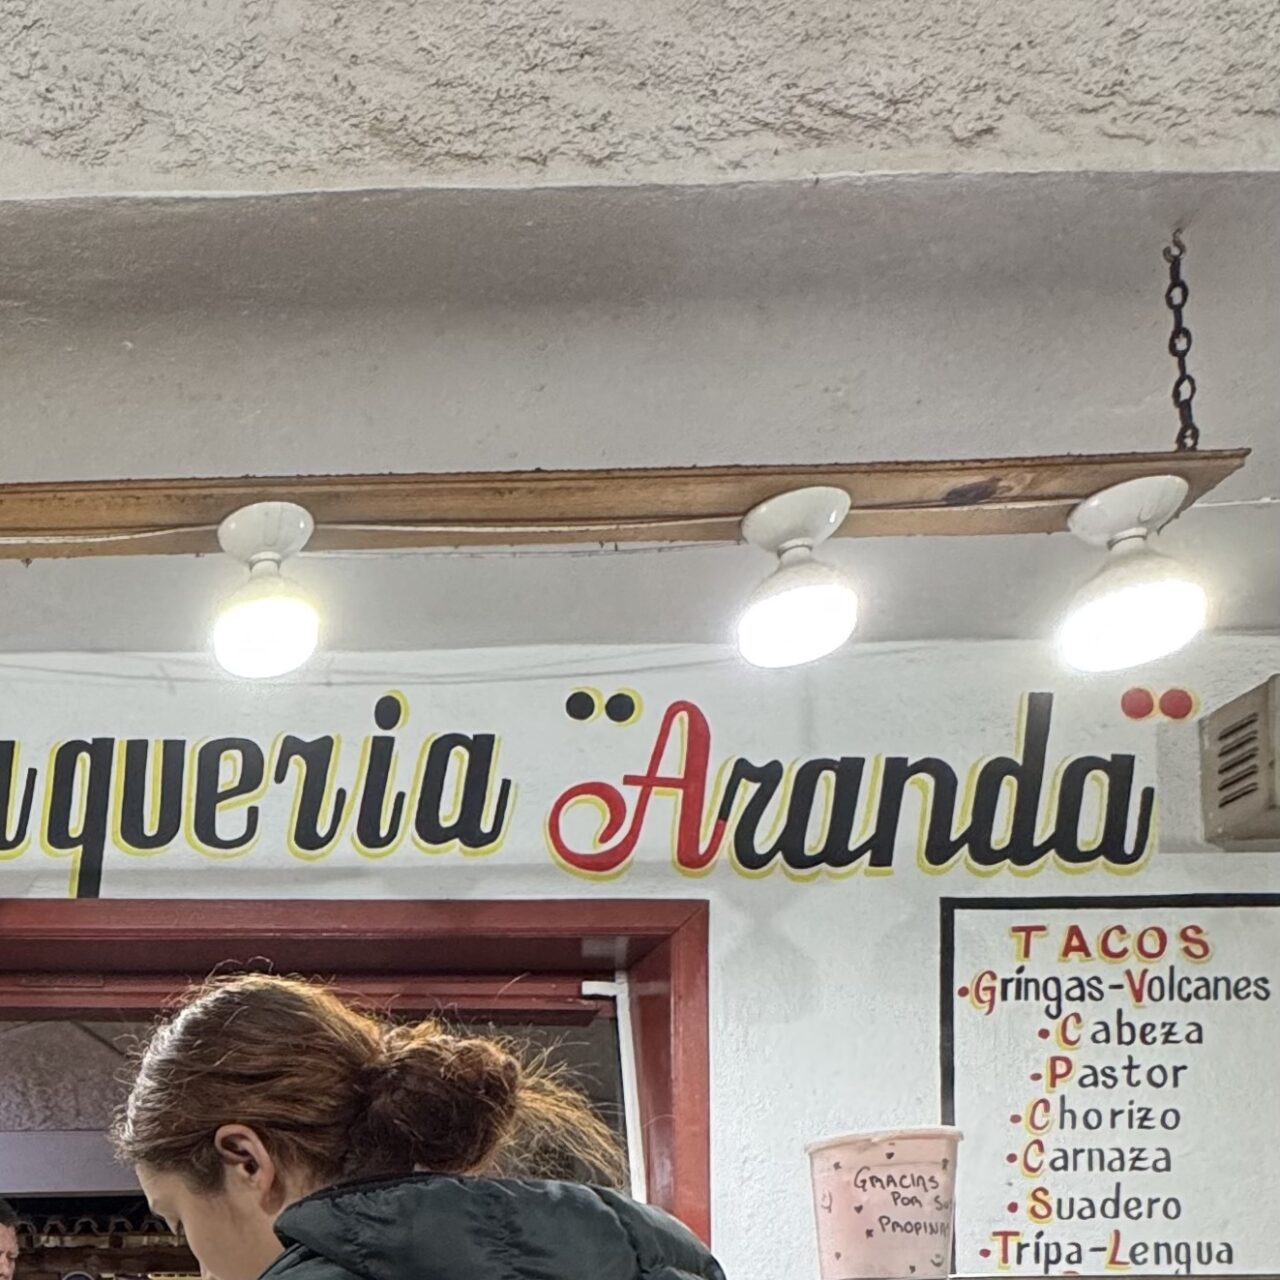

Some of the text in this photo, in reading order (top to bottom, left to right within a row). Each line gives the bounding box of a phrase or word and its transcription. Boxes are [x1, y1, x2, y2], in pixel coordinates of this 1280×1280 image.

[1009, 924, 1212, 962] TACOS
[1055, 1008, 1204, 1046] Cabeza
[1045, 1055, 1188, 1091] Pastor
[1024, 1094, 1181, 1133] Chorizo
[1021, 1138, 1171, 1177] Carnaza
[1027, 1182, 1182, 1223] Suadero
